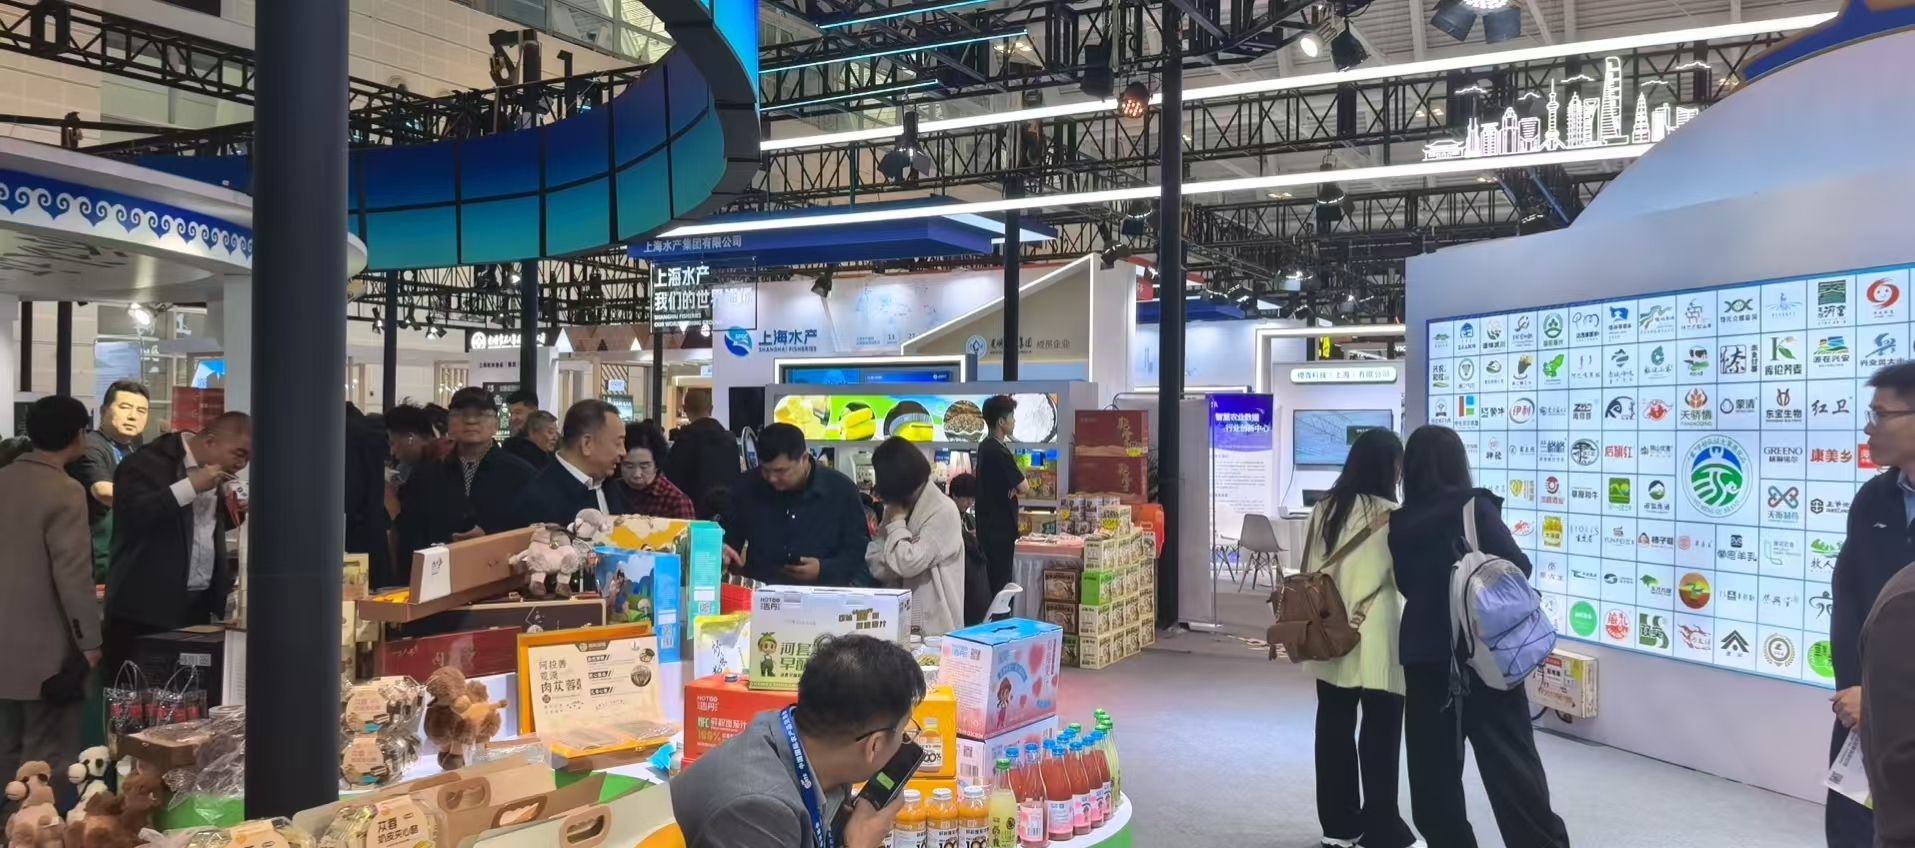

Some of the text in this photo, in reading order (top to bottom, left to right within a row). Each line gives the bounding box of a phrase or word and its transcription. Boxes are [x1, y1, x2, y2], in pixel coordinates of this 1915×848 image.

[643, 235, 742, 253] 上海水产集团有限公司
[654, 264, 710, 287] 上海水产
[758, 329, 818, 346] 上海水产
[990, 336, 1033, 349] 光明集团
[1512, 405, 1531, 417] 伊利
[1765, 409, 1802, 419] 东宝生物
[1811, 398, 1850, 416] 红卫
[1763, 446, 1803, 456] GREENO
[1810, 448, 1853, 463] 康美乡
[539, 659, 567, 669] 阿拉善
[378, 817, 398, 833] 苁蓉
